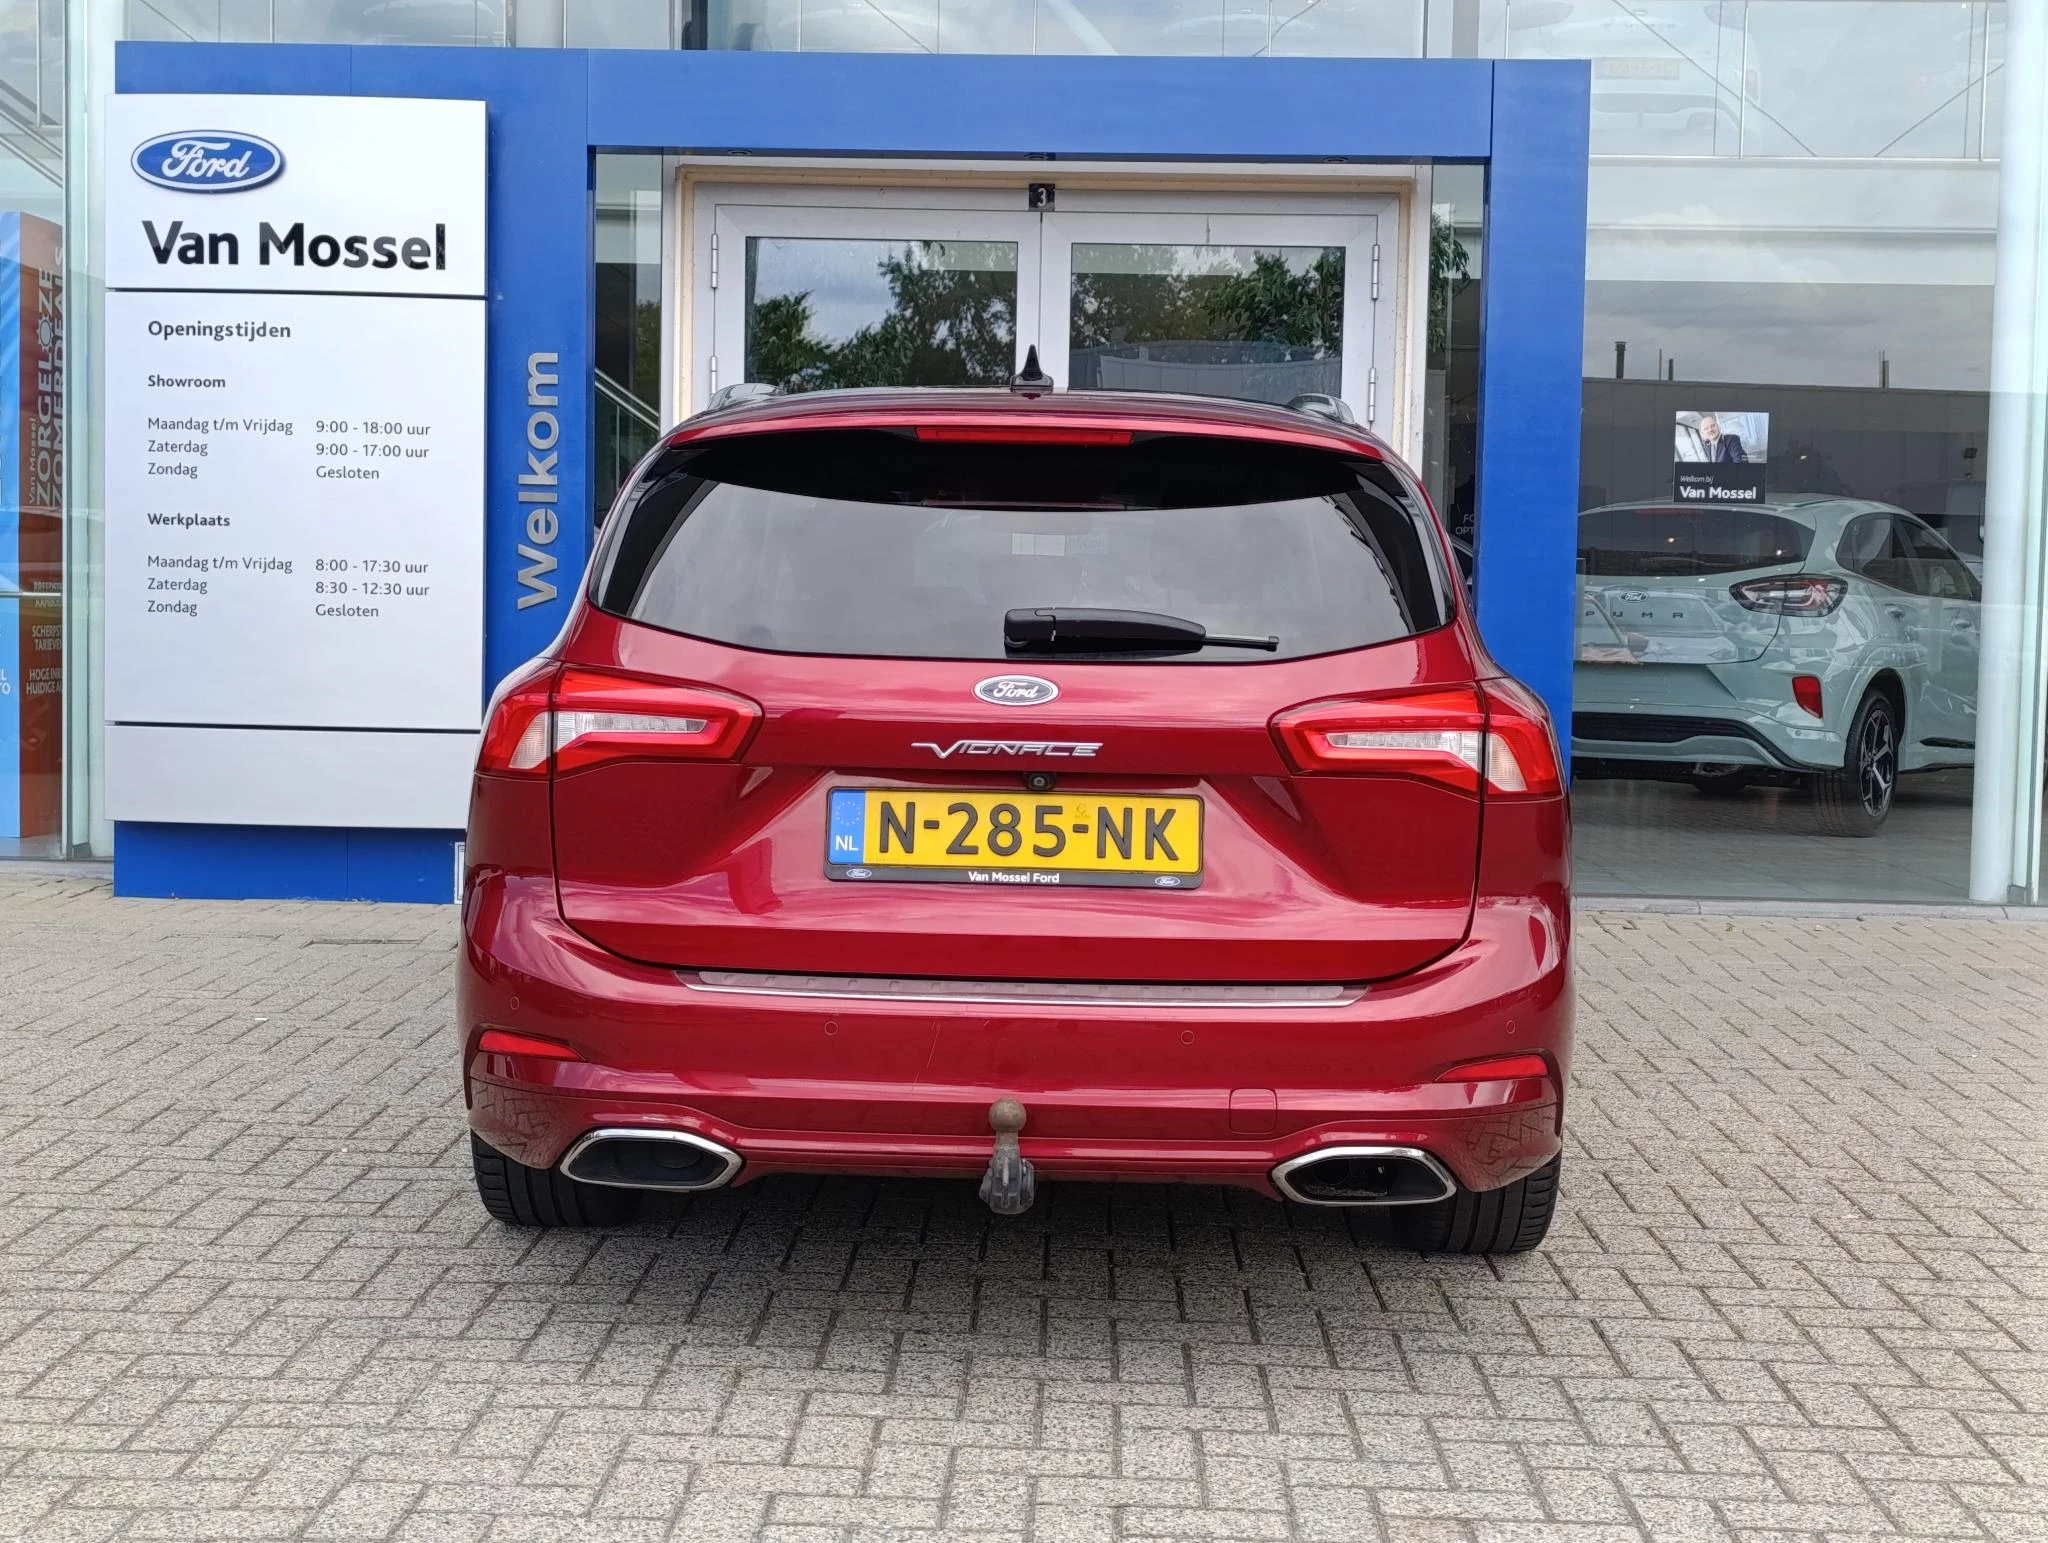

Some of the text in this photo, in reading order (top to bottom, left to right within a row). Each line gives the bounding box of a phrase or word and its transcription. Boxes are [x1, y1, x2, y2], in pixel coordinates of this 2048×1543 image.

[161, 139, 253, 178] Ford
[1037, 187, 1047, 207] 3
[141, 220, 446, 271] Van Mossel
[148, 320, 291, 342] Openingstijden
[147, 374, 226, 388] Showroom
[148, 417, 293, 435] Maandag t/m Vrijdag
[316, 420, 348, 433] 9:00
[363, 421, 403, 435] 18:00
[407, 425, 431, 435] uur
[148, 440, 208, 456] Zaterdag
[316, 443, 348, 456] 9:00
[363, 444, 401, 457] 17:00
[405, 448, 430, 458] uur
[147, 462, 198, 479] Zondag
[316, 465, 380, 479] Gesloten
[517, 352, 560, 610] Welkom
[1680, 475, 1705, 483] Welkom
[1680, 485, 1756, 499] Van Mossel
[147, 512, 231, 530] Werkplaats
[147, 555, 293, 574] Maandag t/m Vrijdag
[315, 558, 348, 572] 8:00
[362, 560, 401, 573] 17:30
[405, 563, 429, 574] uur
[147, 577, 208, 595] Zaterdag
[315, 581, 348, 594] 8:30
[362, 582, 402, 595] 12:30
[406, 586, 430, 596] uur
[147, 600, 198, 617] Zondag
[315, 604, 379, 617] Gesloten
[1585, 610, 1684, 620] PUMA
[993, 681, 1039, 698] Ford
[879, 801, 1180, 860] N-285-NK
[835, 836, 859, 851] NL
[968, 871, 1060, 883] Van Mossel Ford
